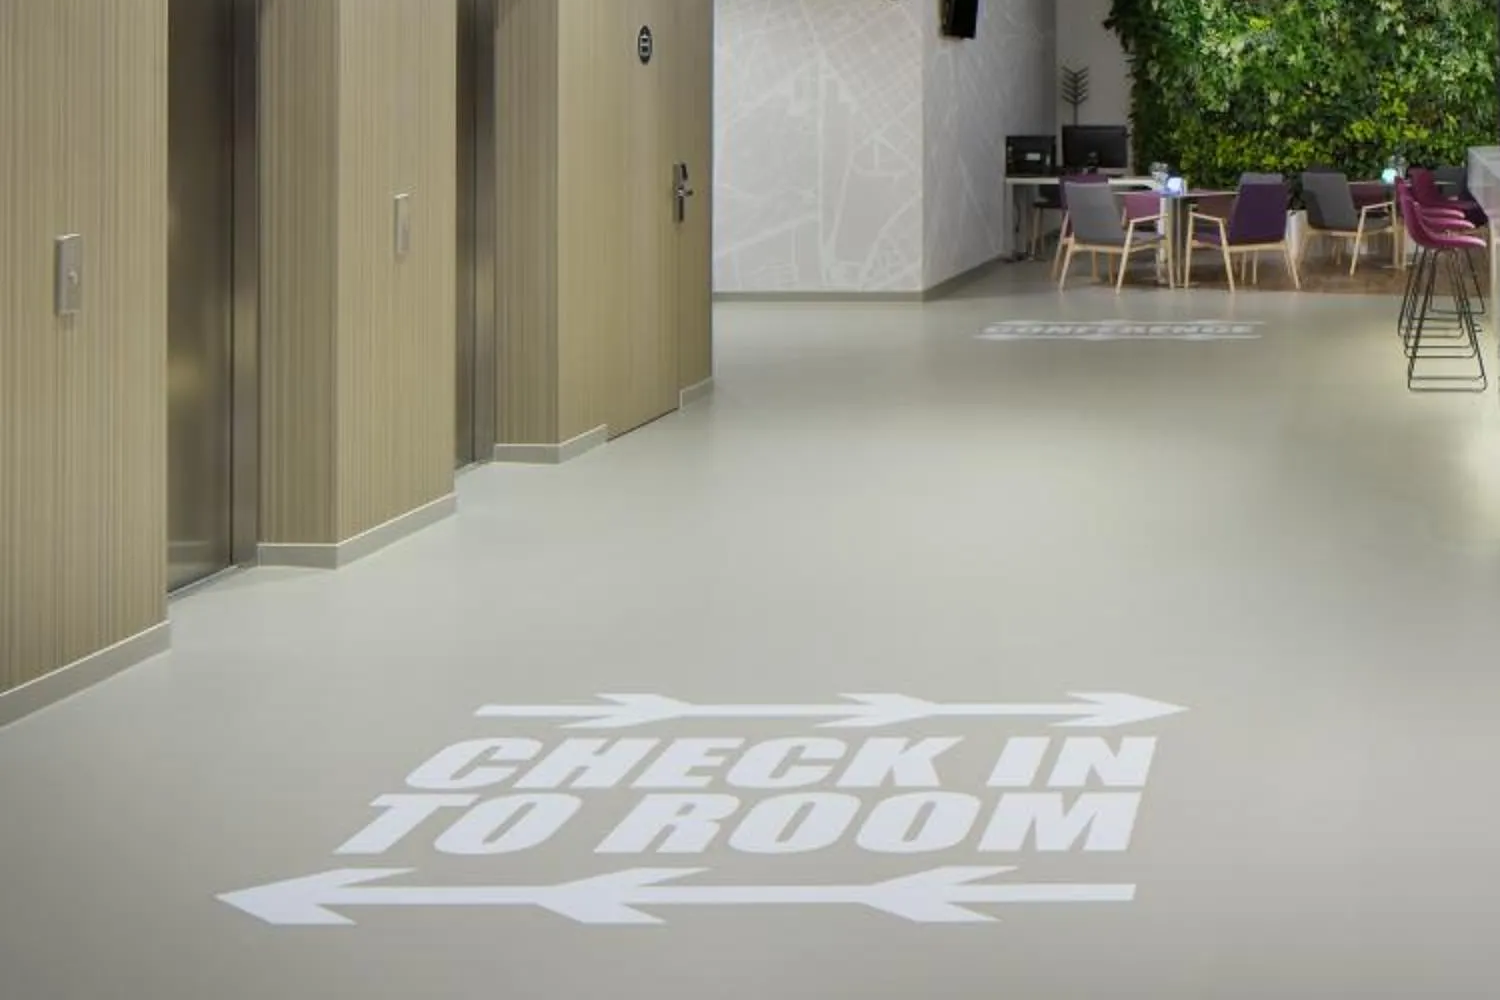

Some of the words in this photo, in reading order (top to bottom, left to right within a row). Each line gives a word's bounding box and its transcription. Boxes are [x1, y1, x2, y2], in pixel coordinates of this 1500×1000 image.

[983, 325, 1254, 335] CONFERENCE
[404, 736, 964, 789] CHECK
[986, 735, 1158, 788] IN
[332, 793, 582, 854] TO
[593, 791, 1143, 854] ROOM
